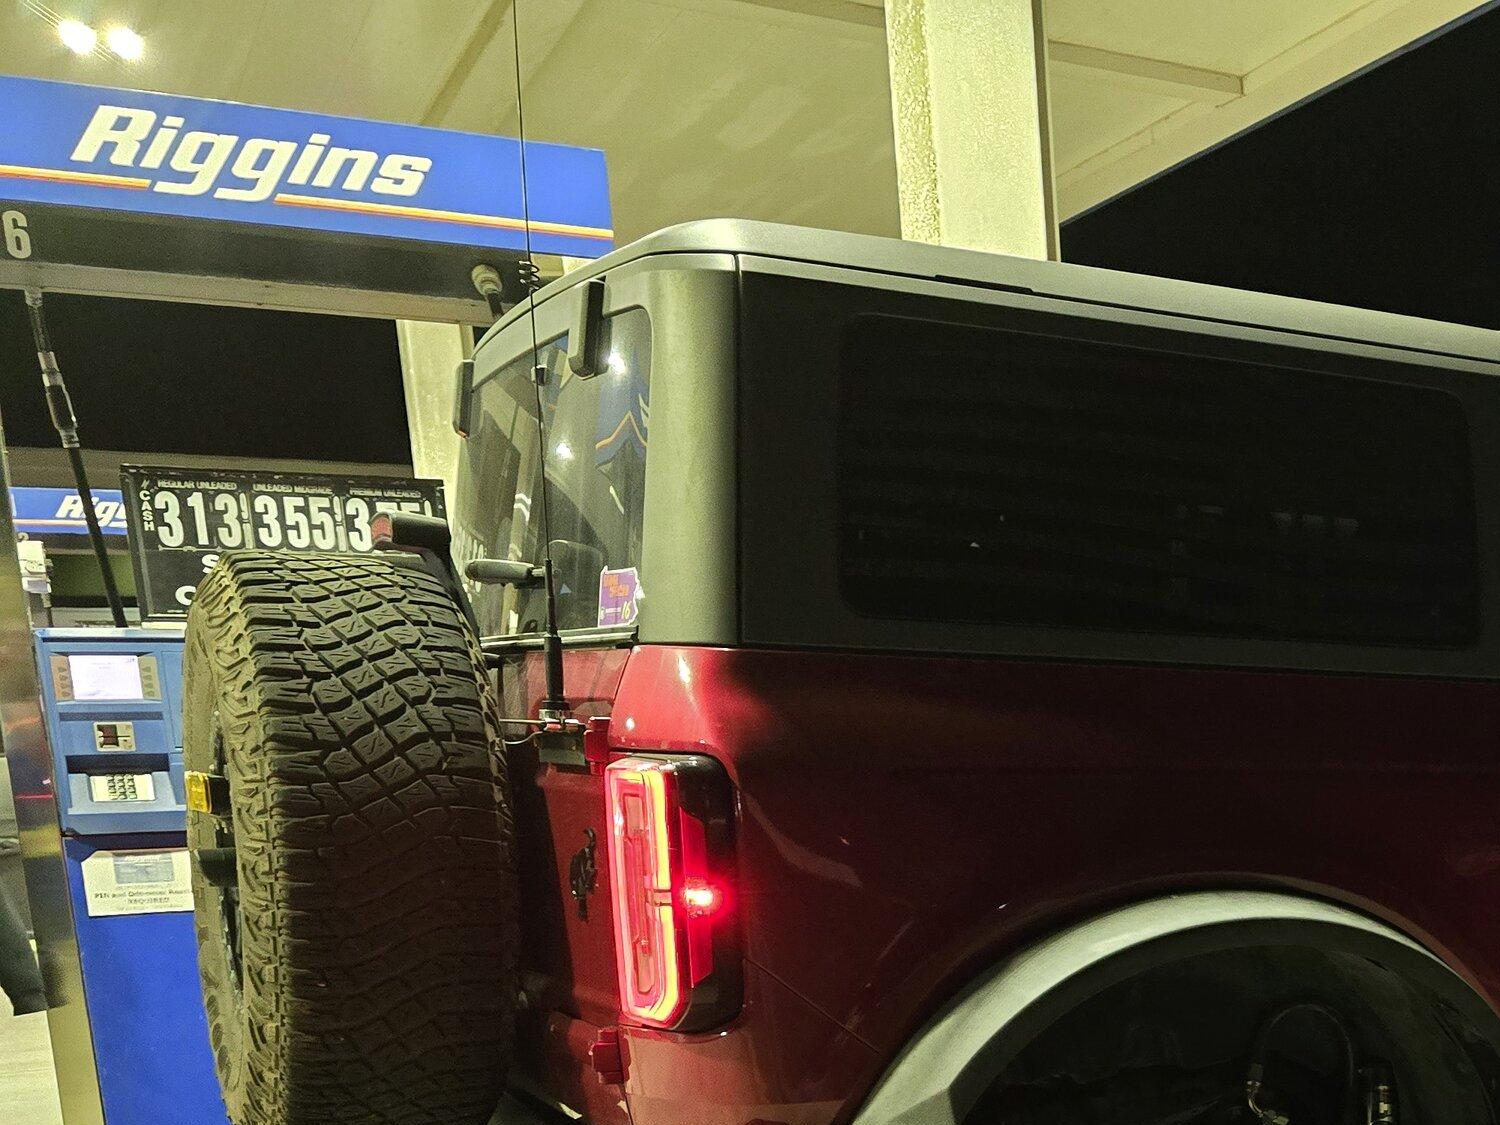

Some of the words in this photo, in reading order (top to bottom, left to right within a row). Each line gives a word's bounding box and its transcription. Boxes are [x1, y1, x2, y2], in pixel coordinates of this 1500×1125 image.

[70, 104, 433, 203] Riggins
[2, 210, 32, 259] 6
[157, 480, 195, 489] REGULAR
[196, 481, 237, 491] UNLEADED
[252, 483, 293, 493] UNLEADED
[139, 489, 155, 532] CASH
